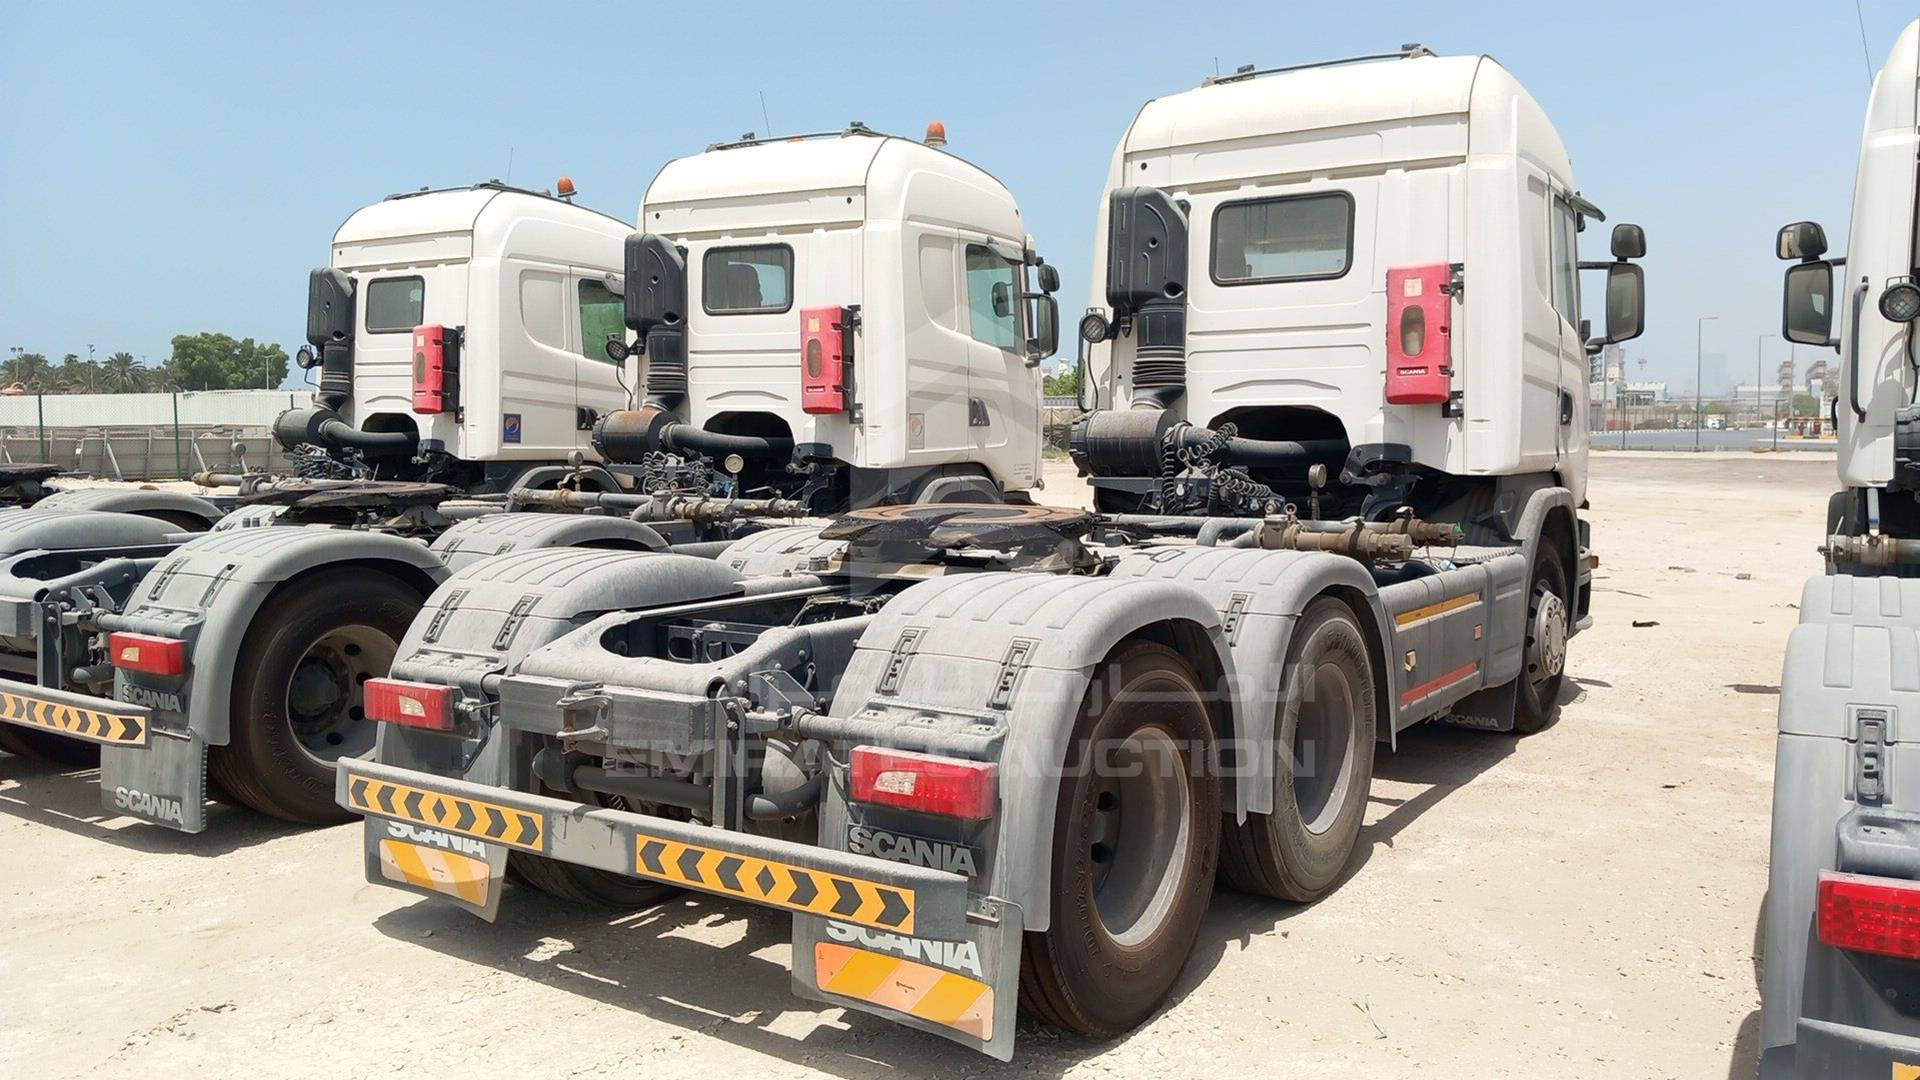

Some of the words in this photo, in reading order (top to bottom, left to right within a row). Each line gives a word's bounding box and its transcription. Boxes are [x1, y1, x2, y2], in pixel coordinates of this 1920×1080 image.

[122, 684, 182, 713] SCANIA
[115, 786, 183, 825] SCANIA
[849, 826, 977, 877] SCANIA
